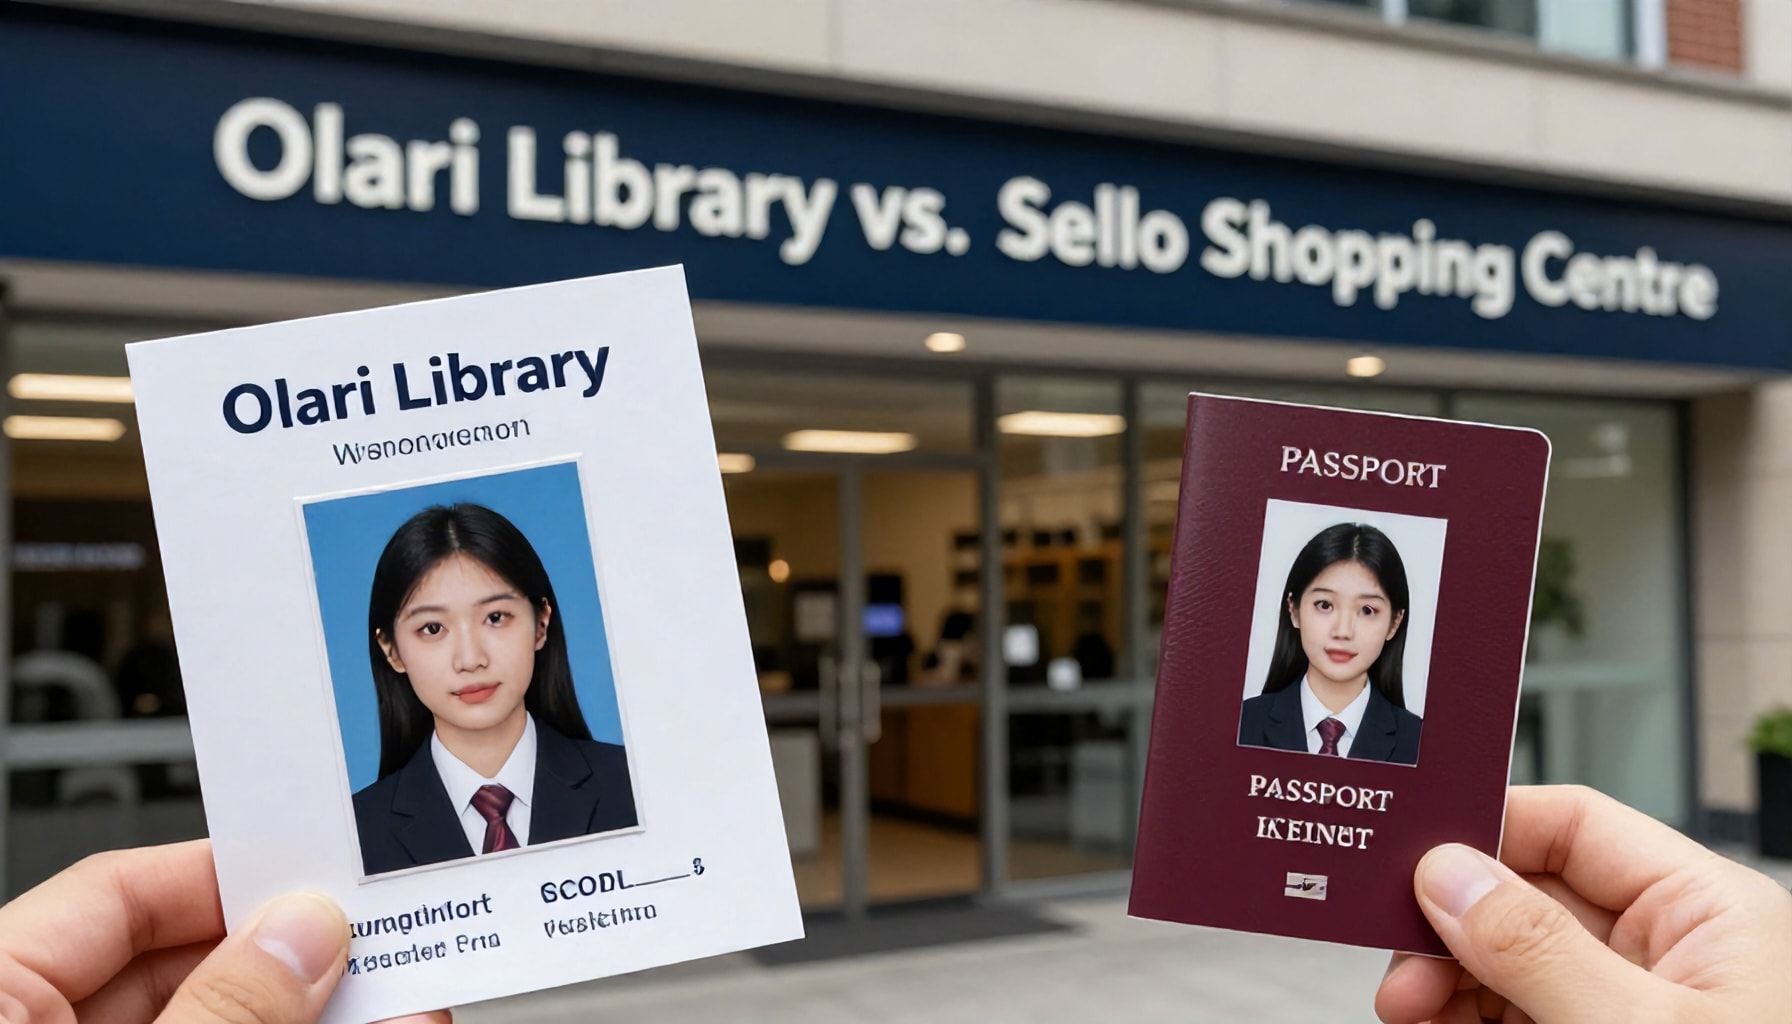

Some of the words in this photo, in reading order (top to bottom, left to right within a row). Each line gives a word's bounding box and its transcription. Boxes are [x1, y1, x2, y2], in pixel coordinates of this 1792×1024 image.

[214, 97, 480, 216] Olari
[507, 126, 837, 264] Library
[853, 184, 970, 255] vs.
[998, 176, 1189, 273] Sello
[1201, 198, 1515, 318] Shopping
[1522, 231, 1718, 319] Centre
[222, 365, 376, 434] Olari
[393, 346, 610, 411] Library
[1280, 445, 1447, 489] PASSPORT
[1248, 774, 1394, 812] PASSPORT
